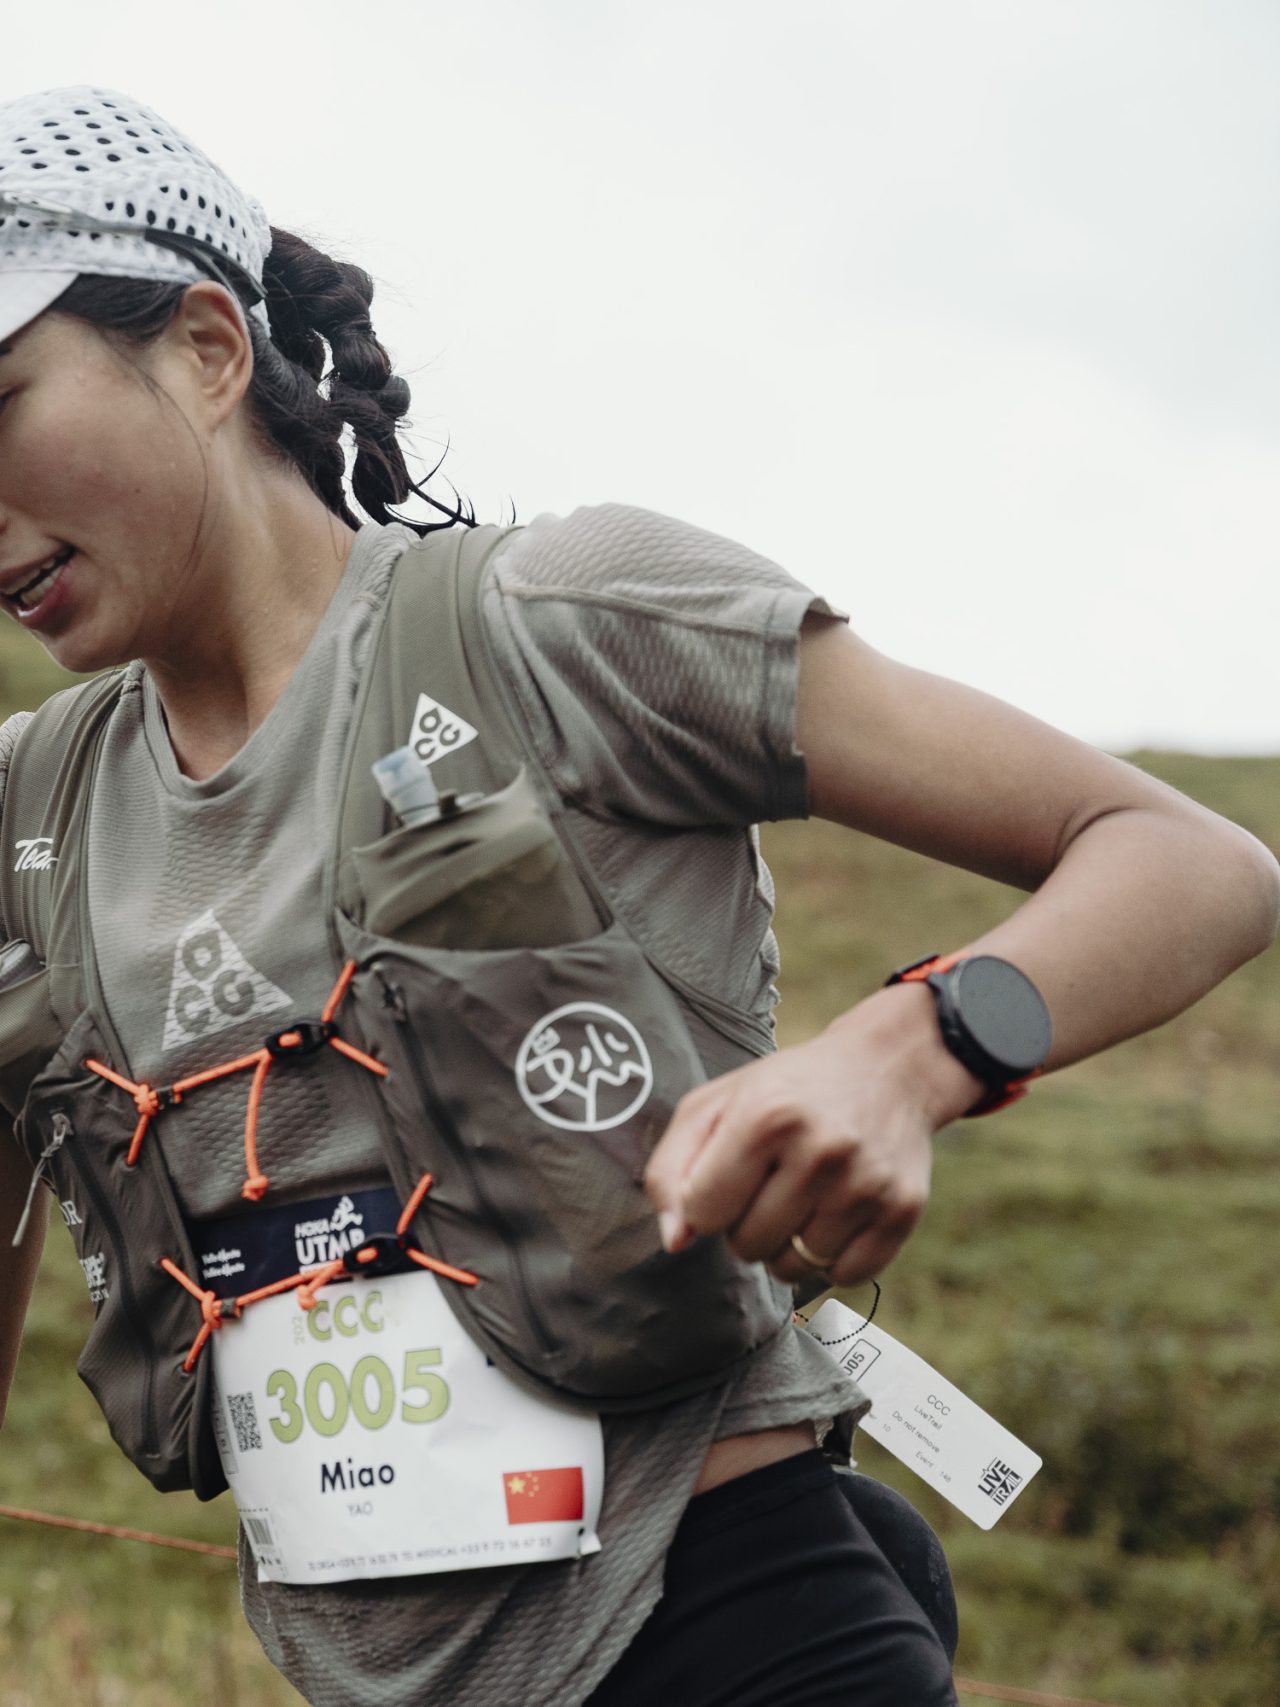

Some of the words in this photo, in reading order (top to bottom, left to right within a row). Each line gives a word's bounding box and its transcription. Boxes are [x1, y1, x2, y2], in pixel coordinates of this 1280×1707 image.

[307, 1289, 385, 1342] CCC
[266, 1347, 451, 1444] 3005
[926, 1394, 952, 1417] CCC
[892, 1410, 903, 1422] Do
[903, 1420, 917, 1433] not
[915, 1430, 940, 1453] remove
[321, 1457, 395, 1493] Miao
[977, 1459, 1011, 1496] LIVE
[991, 1470, 1024, 1506] TRAIL
[347, 1500, 374, 1517] YAO
